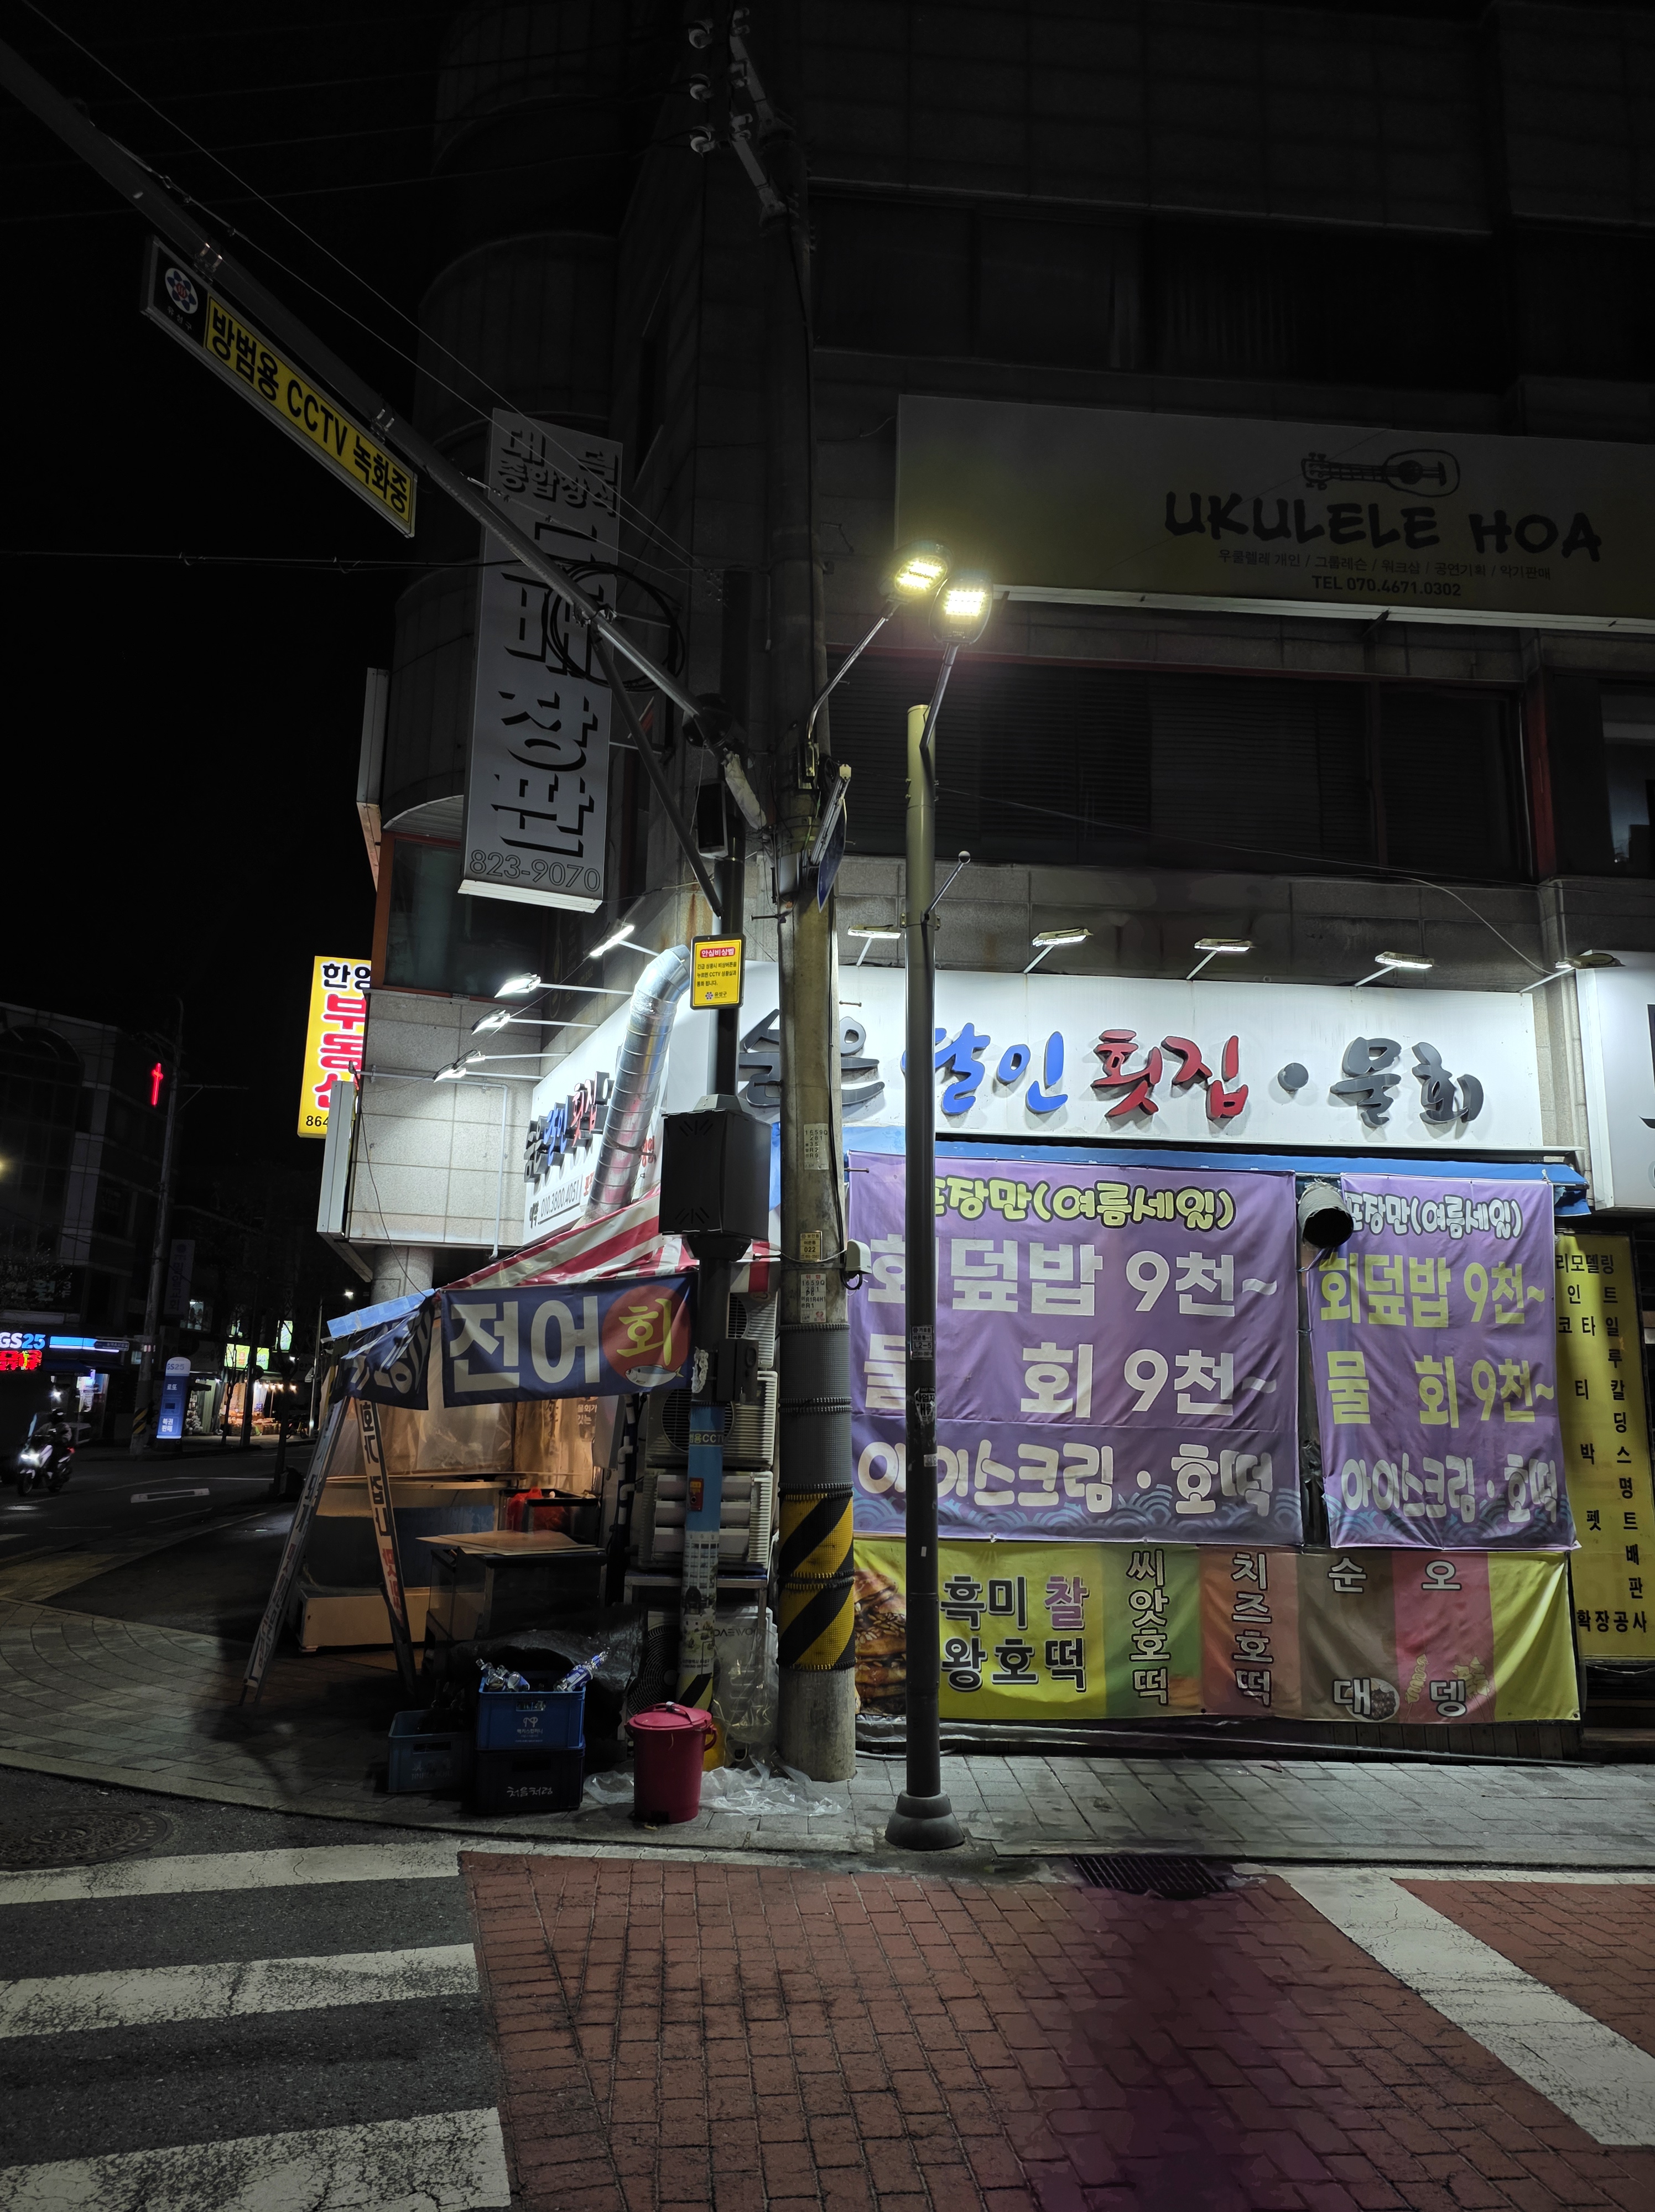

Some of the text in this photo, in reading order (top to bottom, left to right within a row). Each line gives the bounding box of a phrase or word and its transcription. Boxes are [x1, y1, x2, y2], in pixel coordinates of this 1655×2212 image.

[166, 305, 192, 330] 유성구
[212, 306, 408, 513] 방범용 CCTV 녹화중
[1165, 490, 1602, 562] UKULELE HOA
[1218, 549, 1551, 581] 우쿨렐레 개인 그룹레슨 워크샵 공연기획 악기판매
[1311, 575, 1462, 597] TEL 070.4671.0302
[470, 849, 601, 892] 823-9070
[701, 948, 735, 957] 안심비상벨
[1091, 1029, 1250, 1121] 횟집
[1330, 1036, 1485, 1129] 물회
[540, 1179, 580, 1218] 010.3800.4051
[1125, 1250, 1277, 1317] 9천~
[1319, 1252, 1545, 1327] 회덮밥 9천~
[1555, 1253, 1615, 1275] 리모델링
[0, 1332, 46, 1349] GS25
[449, 1295, 601, 1394] 전어
[616, 1297, 675, 1366] 회
[1123, 1348, 1277, 1417] 9천~
[1470, 1358, 1554, 1423] 9천~
[1171, 1443, 1273, 1517] 호떡
[1341, 1452, 1558, 1524] 아이스크림 호떡
[1126, 1548, 1170, 1705] 씨앗호떡
[1231, 1552, 1274, 1707] 치즈호떡
[1576, 1609, 1647, 1633] 확장공사
[941, 1636, 1088, 1693] 왕호떡
[506, 1786, 553, 1798] 처음처럼
